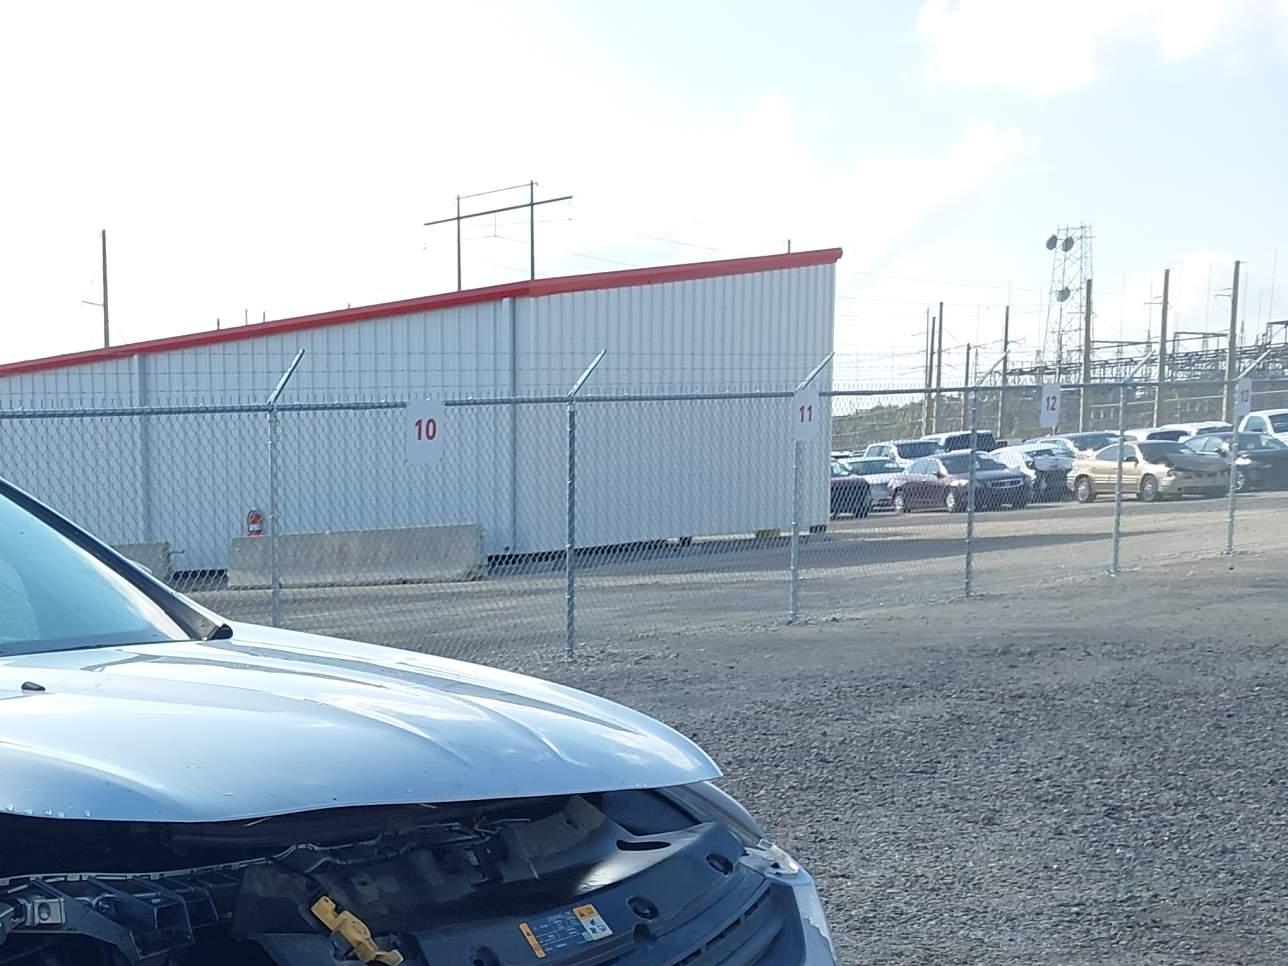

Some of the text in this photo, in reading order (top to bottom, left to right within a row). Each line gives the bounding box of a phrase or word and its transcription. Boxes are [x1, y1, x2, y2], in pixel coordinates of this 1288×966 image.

[1046, 395, 1057, 411] 12
[799, 405, 812, 423] 11
[415, 418, 437, 441] 10
